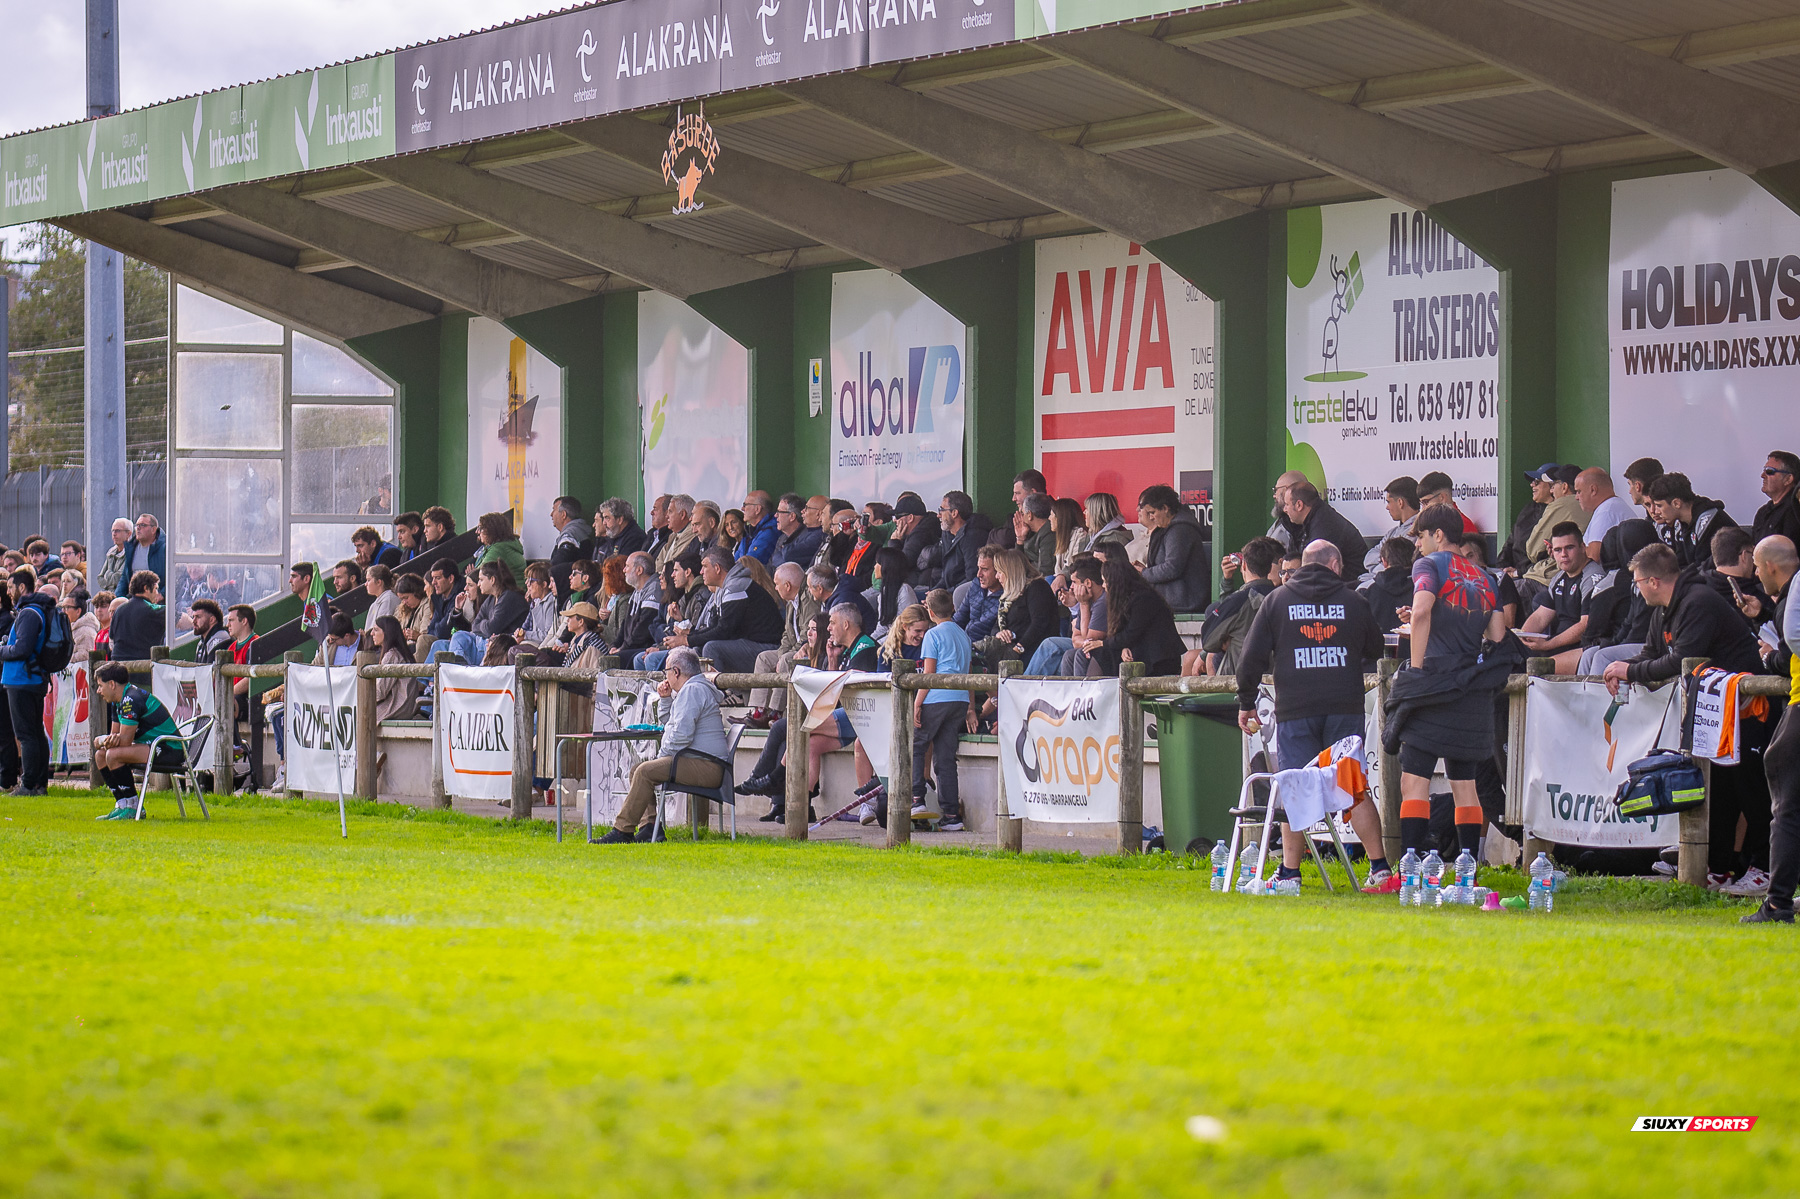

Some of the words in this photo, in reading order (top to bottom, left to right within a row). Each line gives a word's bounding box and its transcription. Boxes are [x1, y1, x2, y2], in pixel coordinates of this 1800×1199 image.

[962, 11, 992, 30] echebastar
[616, 13, 733, 80] ALAKRANA
[755, 51, 782, 68] echebastar
[351, 83, 369, 101] GRUPO
[450, 52, 555, 114] ALAKRANA
[573, 87, 598, 103] echebastar
[229, 108, 247, 126] GRUPO
[325, 94, 382, 146] Intxausti
[411, 119, 432, 135] echebastar
[122, 133, 138, 149] GRUPO
[209, 119, 258, 169] Intxausti
[661, 113, 720, 186] BASURDE
[24, 153, 39, 169] GRUPO
[101, 143, 148, 190] Intxausti
[5, 163, 48, 208] Intxausti
[1388, 210, 1476, 279] ALQUILE
[1622, 254, 1800, 331] HOLIDAYS
[1042, 241, 1175, 396] AVIA
[1393, 290, 1499, 362] TRASTEROS
[1623, 335, 1800, 376] WWW.HOLIDAYS.XXX
[839, 350, 904, 439] alba
[1185, 398, 1196, 416] DE
[1293, 389, 1378, 424] trasteleku
[1389, 383, 1413, 423] Tel.
[1418, 382, 1443, 422] 658
[1448, 381, 1473, 420] 497
[1478, 378, 1499, 419] 81
[494, 460, 540, 481] ALAKRANA
[838, 450, 867, 467] Emission
[868, 448, 881, 466] Free
[882, 448, 903, 469] Energy
[916, 446, 946, 463] Petronor
[1180, 489, 1210, 505] DIESEL
[1341, 487, 1362, 501] Edificio
[1287, 604, 1346, 621] ABELLES
[1293, 646, 1348, 669] RUGBY
[1071, 697, 1097, 721] BAR
[448, 710, 510, 752] CAMBER
[1546, 783, 1659, 833] Torrea
